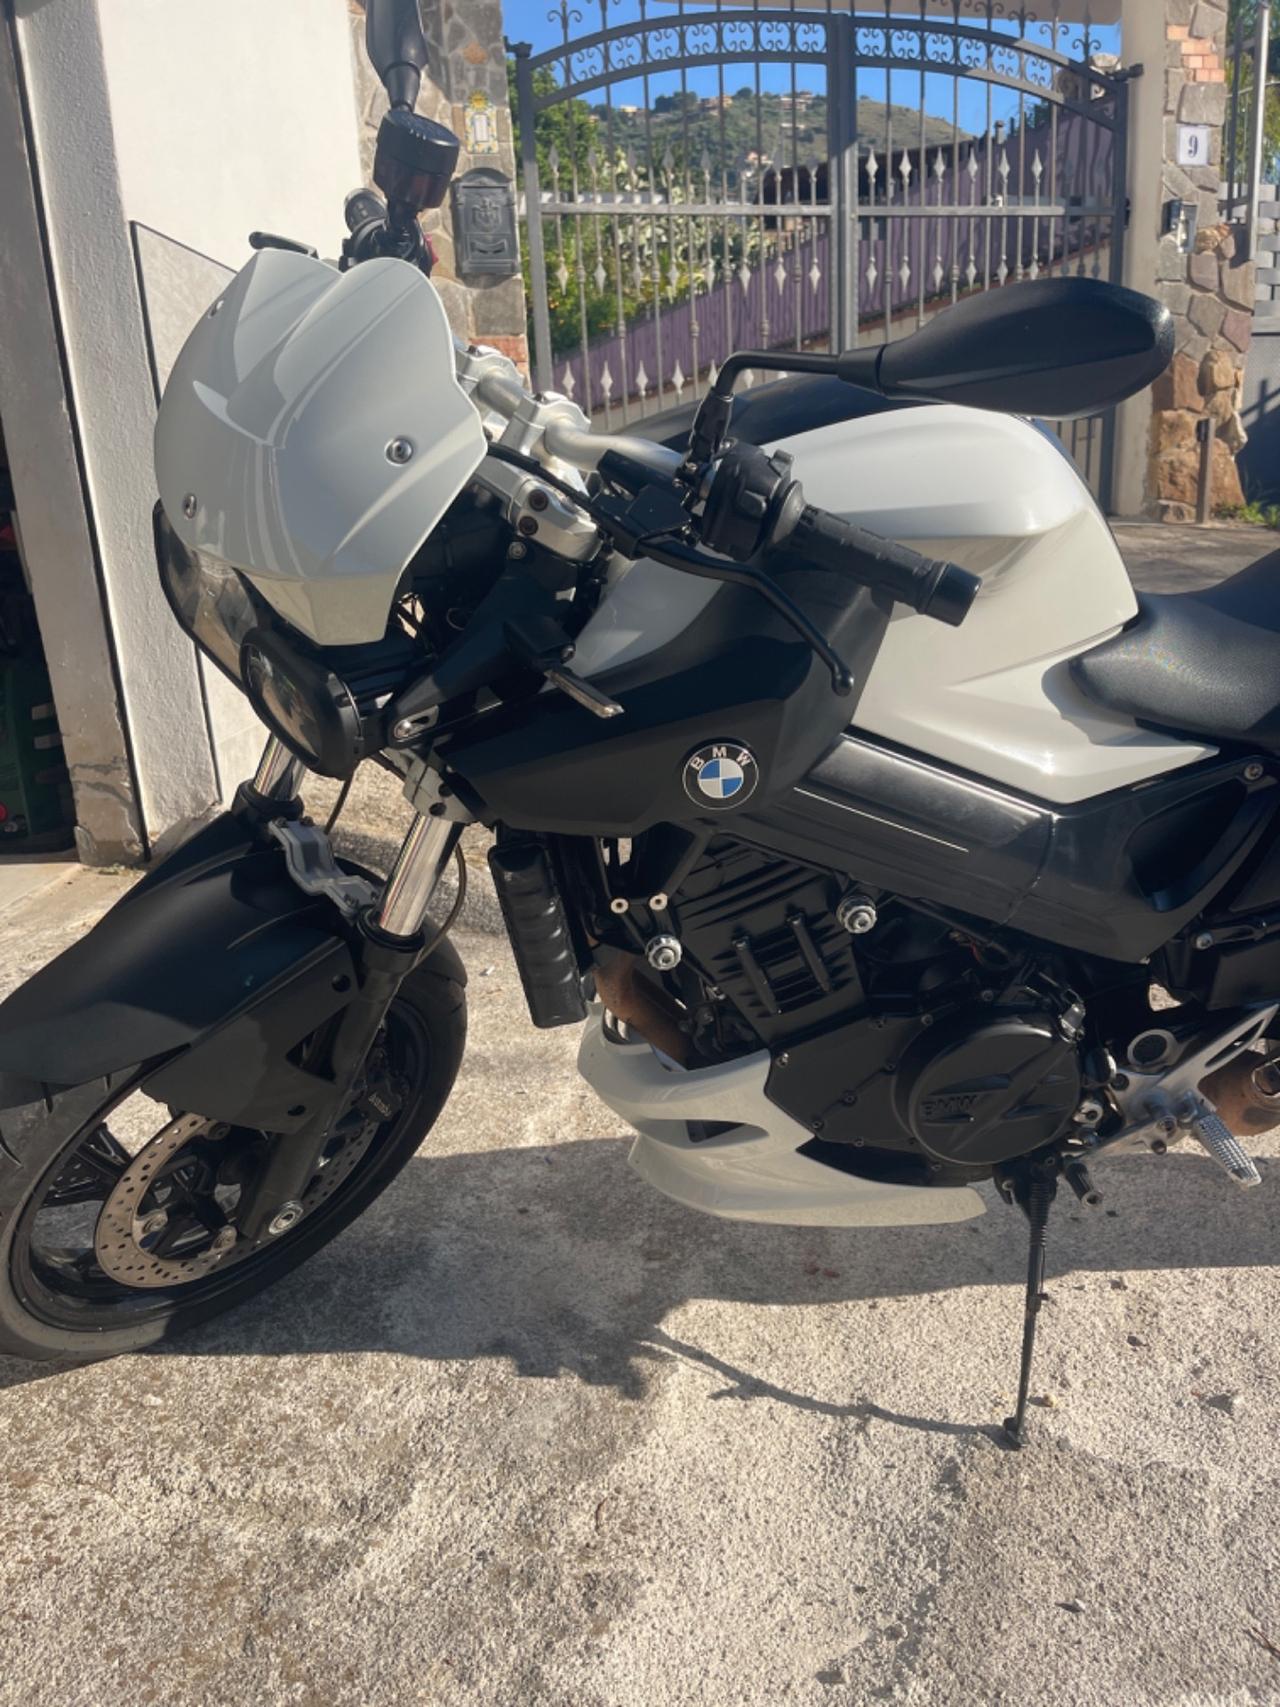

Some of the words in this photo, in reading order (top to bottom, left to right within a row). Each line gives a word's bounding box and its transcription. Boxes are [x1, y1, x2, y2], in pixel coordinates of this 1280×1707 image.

[1188, 135, 1198, 158] 9
[690, 746, 751, 771] BMW
[921, 1095, 977, 1118] BMW
